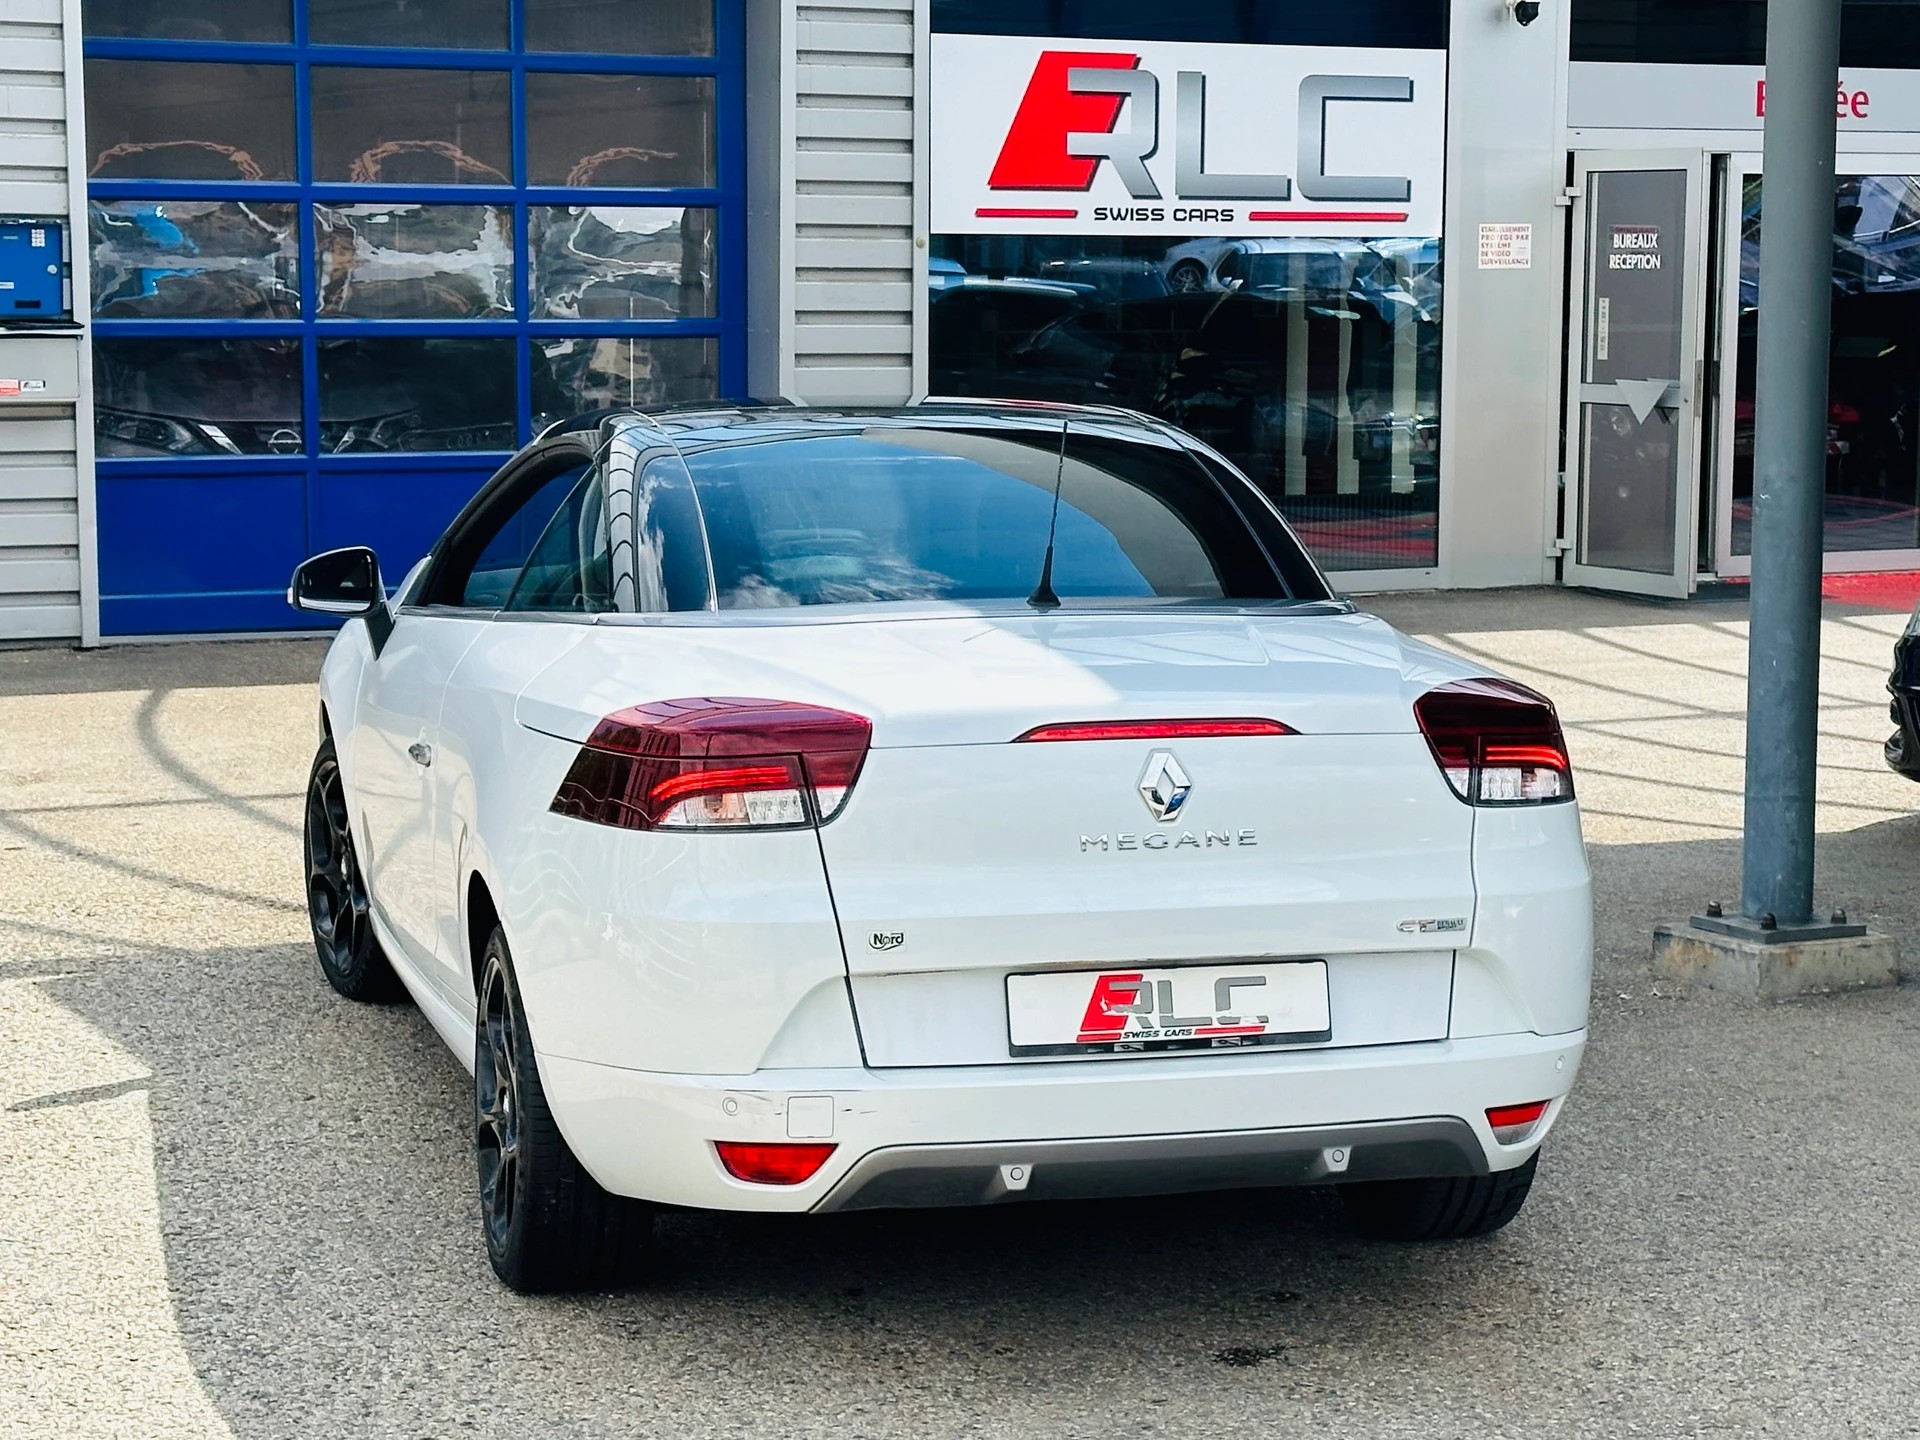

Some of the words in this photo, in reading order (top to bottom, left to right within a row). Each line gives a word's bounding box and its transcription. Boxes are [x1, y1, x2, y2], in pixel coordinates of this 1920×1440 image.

[1093, 207, 1165, 222] SWISS
[1172, 208, 1235, 222] CARS
[1613, 233, 1659, 249] BUREAUX
[1609, 254, 1661, 269] RECEPTION
[1079, 828, 1258, 852] MEGANE
[873, 932, 904, 946] Nord
[1122, 1030, 1160, 1039] SWISS
[1164, 1028, 1192, 1037] CARS
